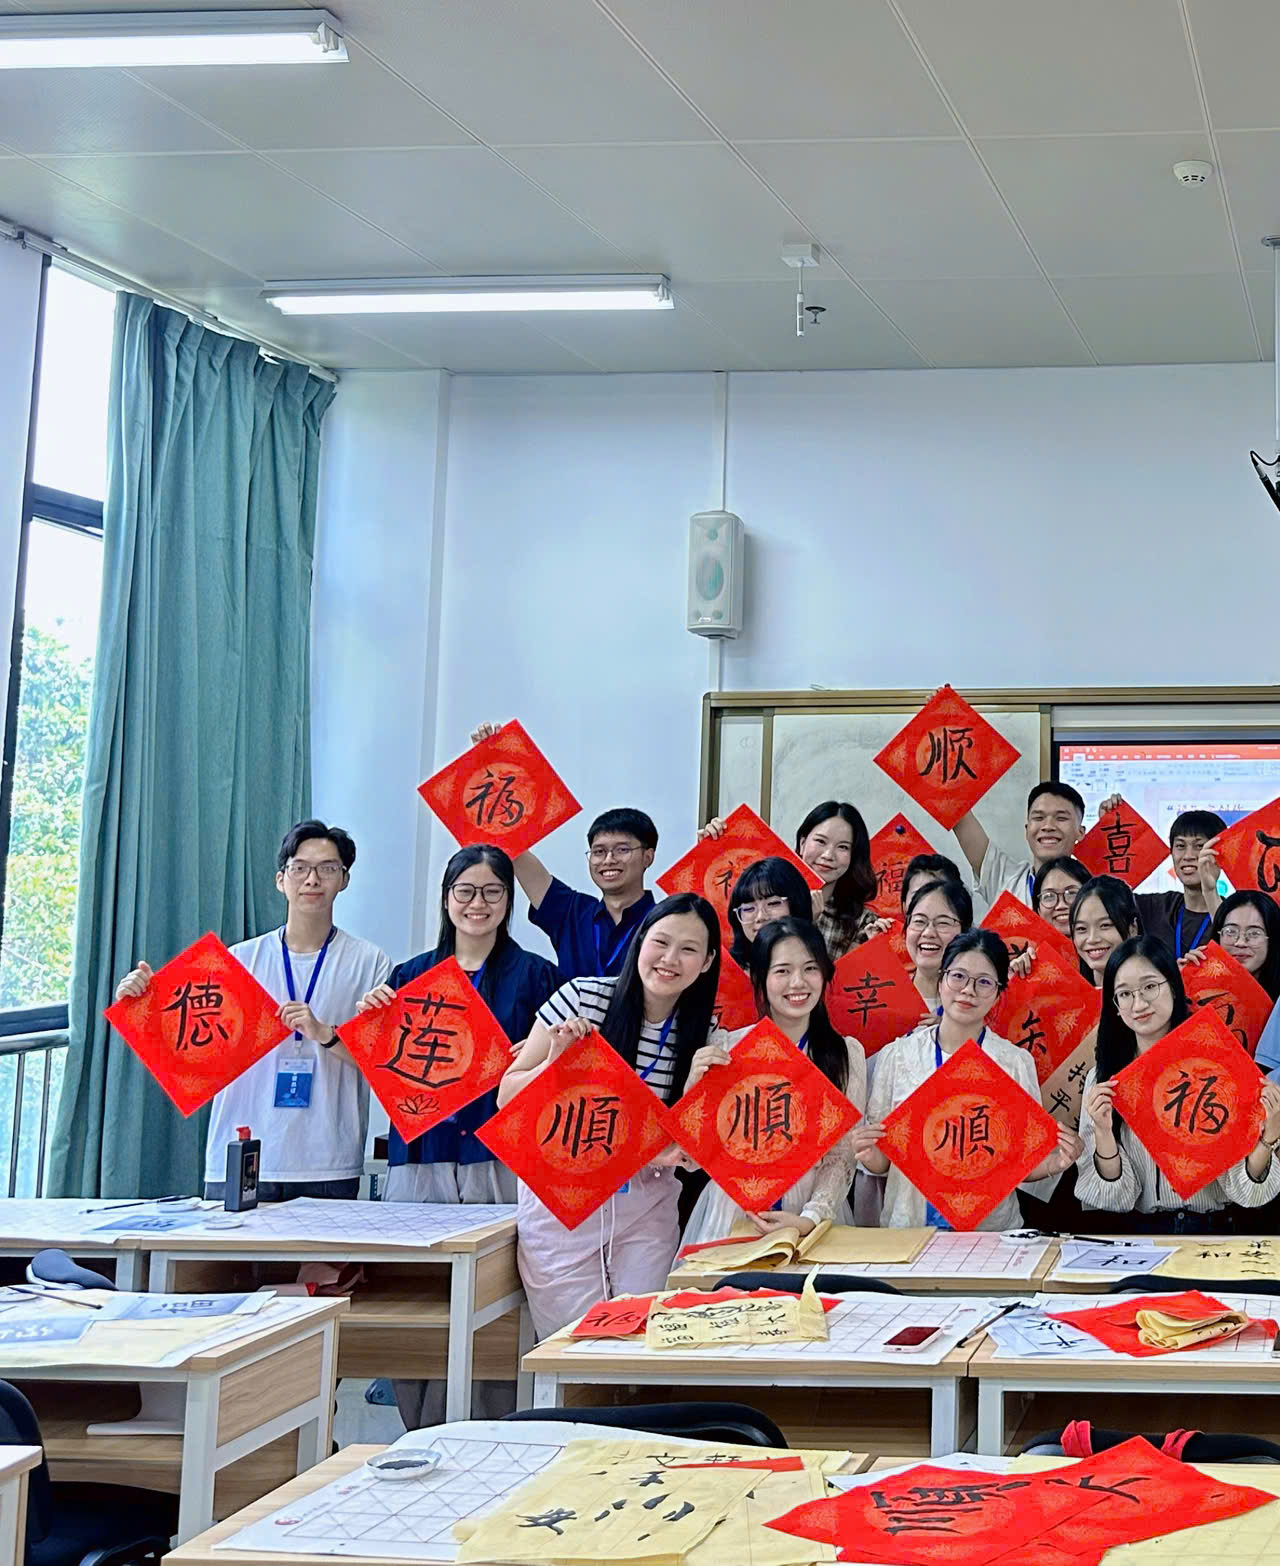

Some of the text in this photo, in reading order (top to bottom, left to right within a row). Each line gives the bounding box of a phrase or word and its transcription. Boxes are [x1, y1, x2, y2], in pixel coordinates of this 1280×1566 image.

[920, 727, 977, 783] 顺
[465, 770, 525, 827] 福
[1101, 814, 1137, 874] 喜
[161, 976, 230, 1051] 德
[843, 971, 896, 1028] 幸
[377, 993, 467, 1089] 莲
[541, 1096, 621, 1159] 順
[728, 1081, 794, 1152] 順
[934, 1104, 997, 1161] 順
[1166, 1069, 1230, 1136] 福
